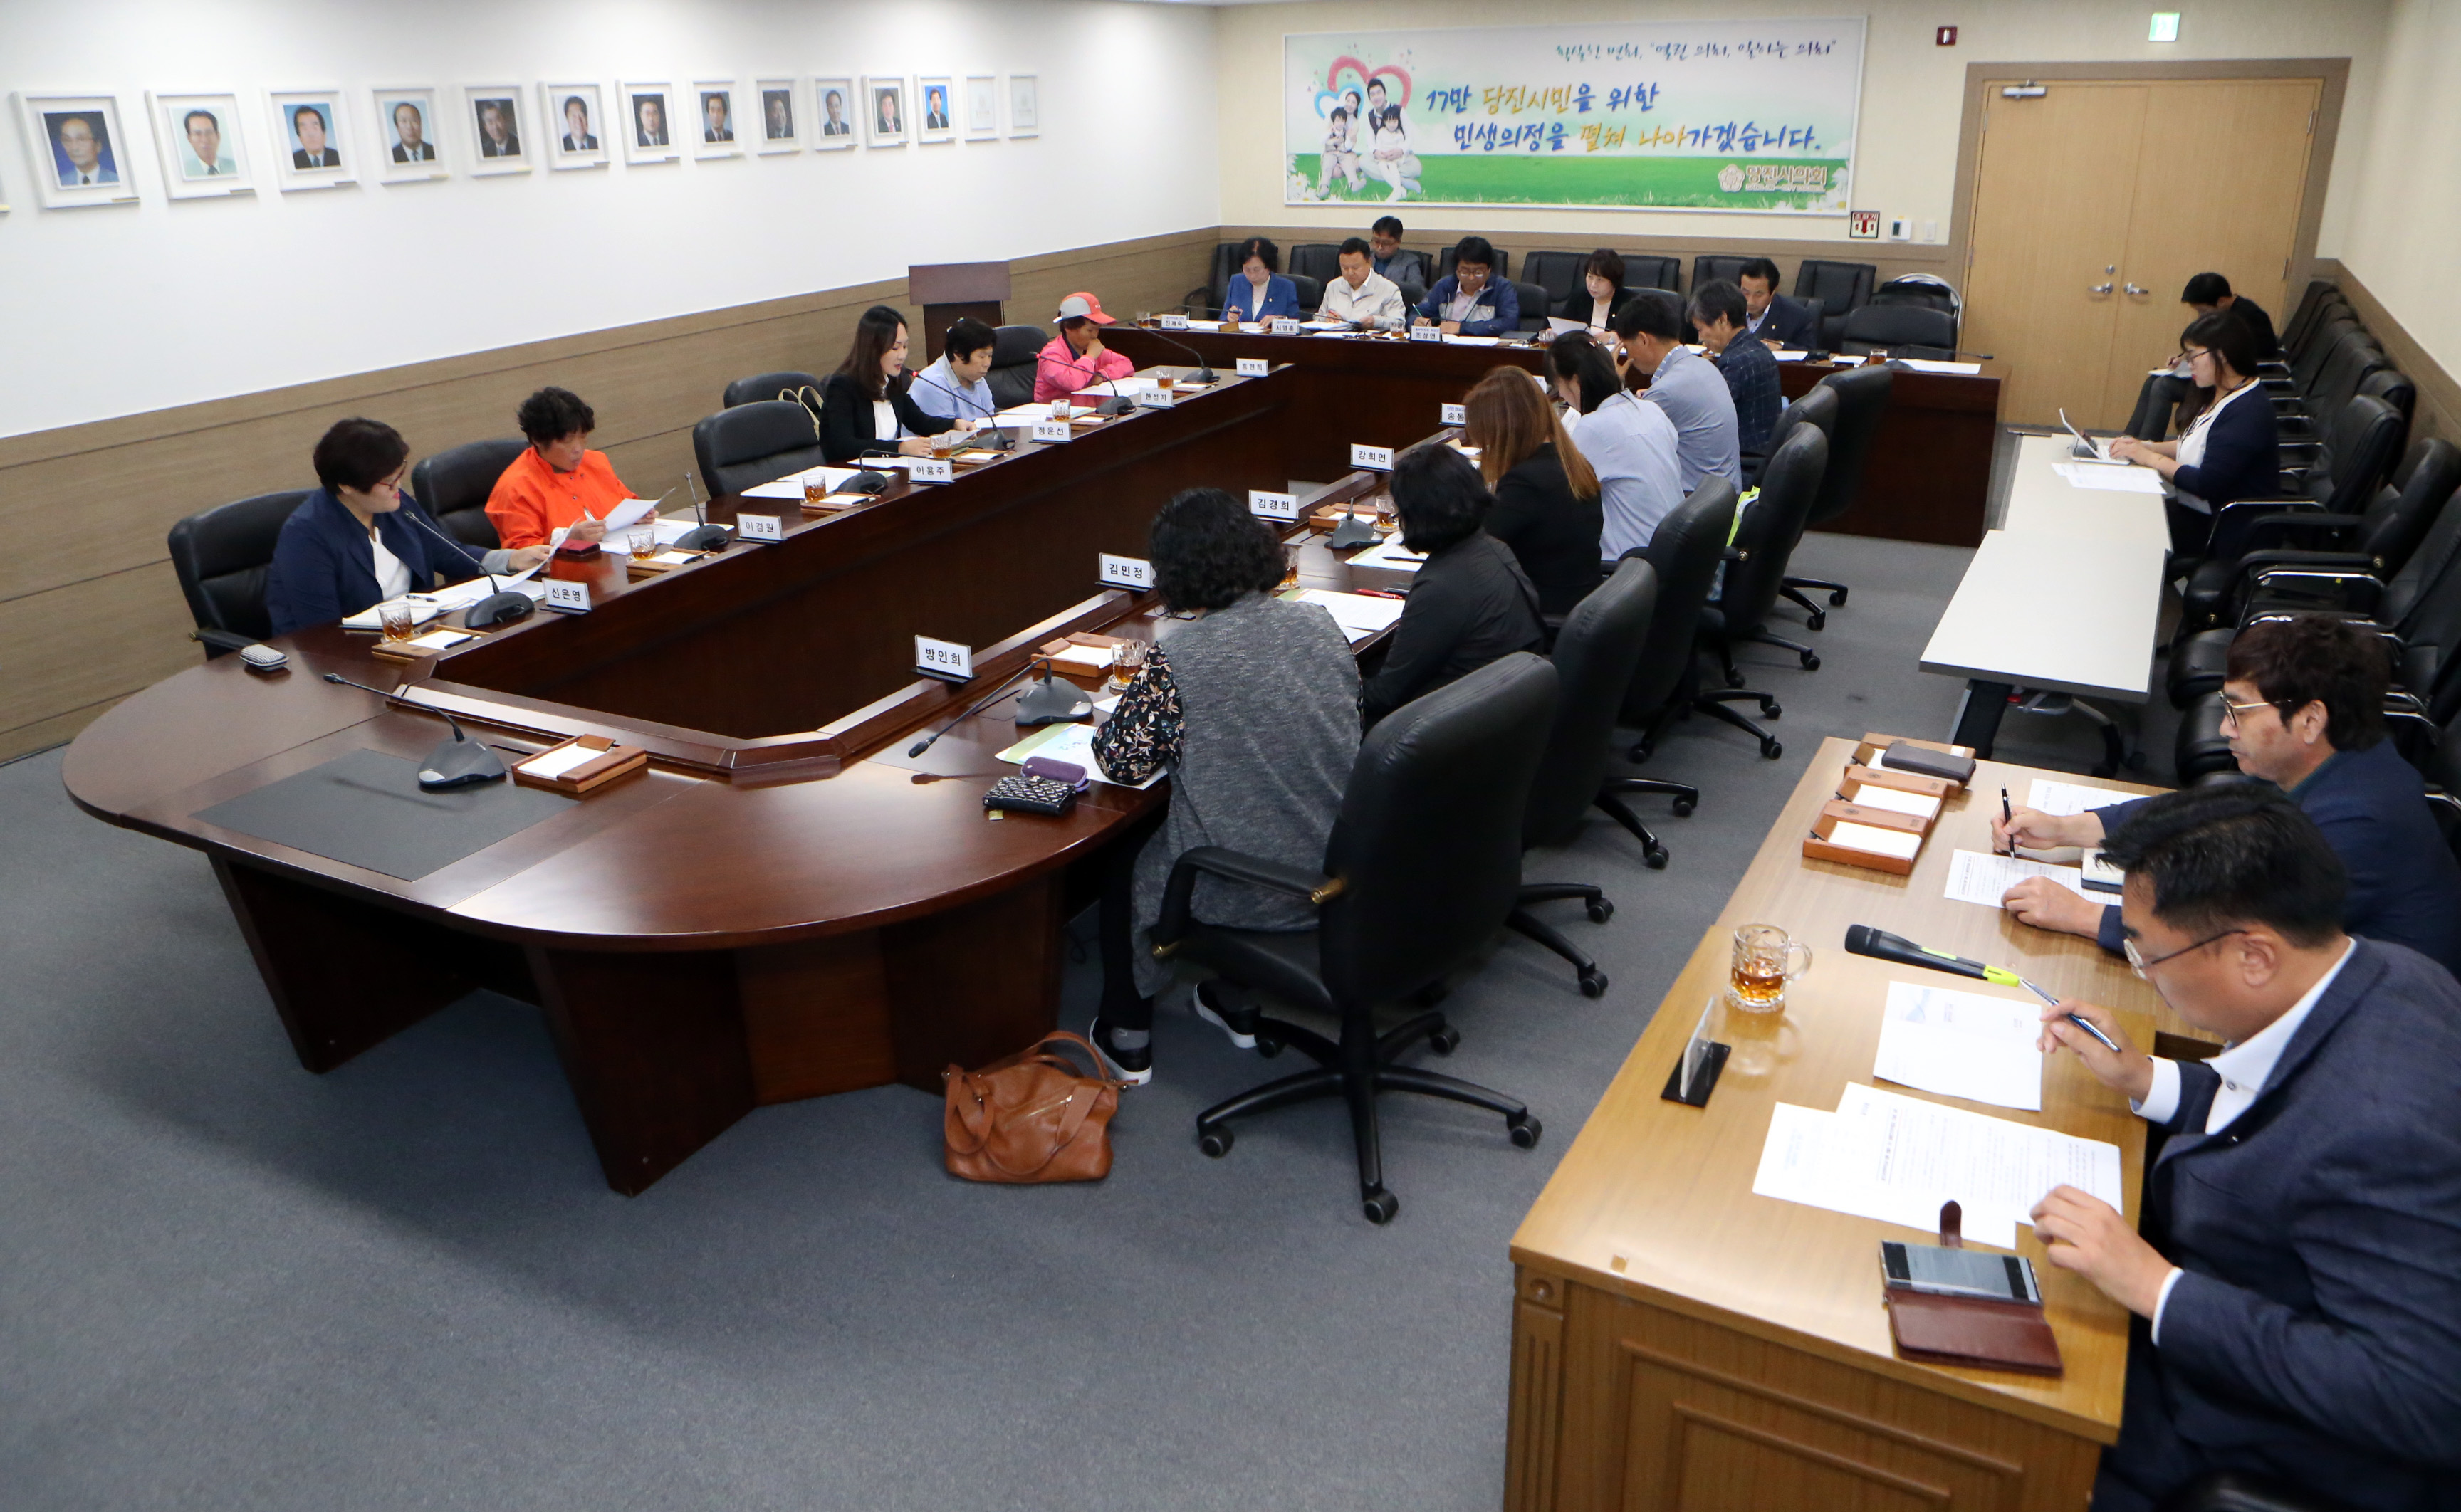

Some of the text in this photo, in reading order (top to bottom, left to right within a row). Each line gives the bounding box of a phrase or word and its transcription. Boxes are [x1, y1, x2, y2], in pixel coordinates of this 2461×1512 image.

[1426, 81, 1660, 115] 17만 당진시민을 위한
[1454, 120, 1822, 152] 민생의정을 펼쳐 나아가겠습니다.
[1746, 165, 1827, 185] 당진시의회
[1447, 412, 1465, 421] 송동
[1038, 426, 1064, 436] 정윤선
[1358, 451, 1386, 463] 강희연
[916, 466, 945, 476] 이용주
[1258, 498, 1290, 511] 김경희
[746, 522, 774, 533] 이경원
[1109, 563, 1143, 579] 김민정
[552, 588, 581, 602] 신은영
[925, 647, 961, 667] 방인희
